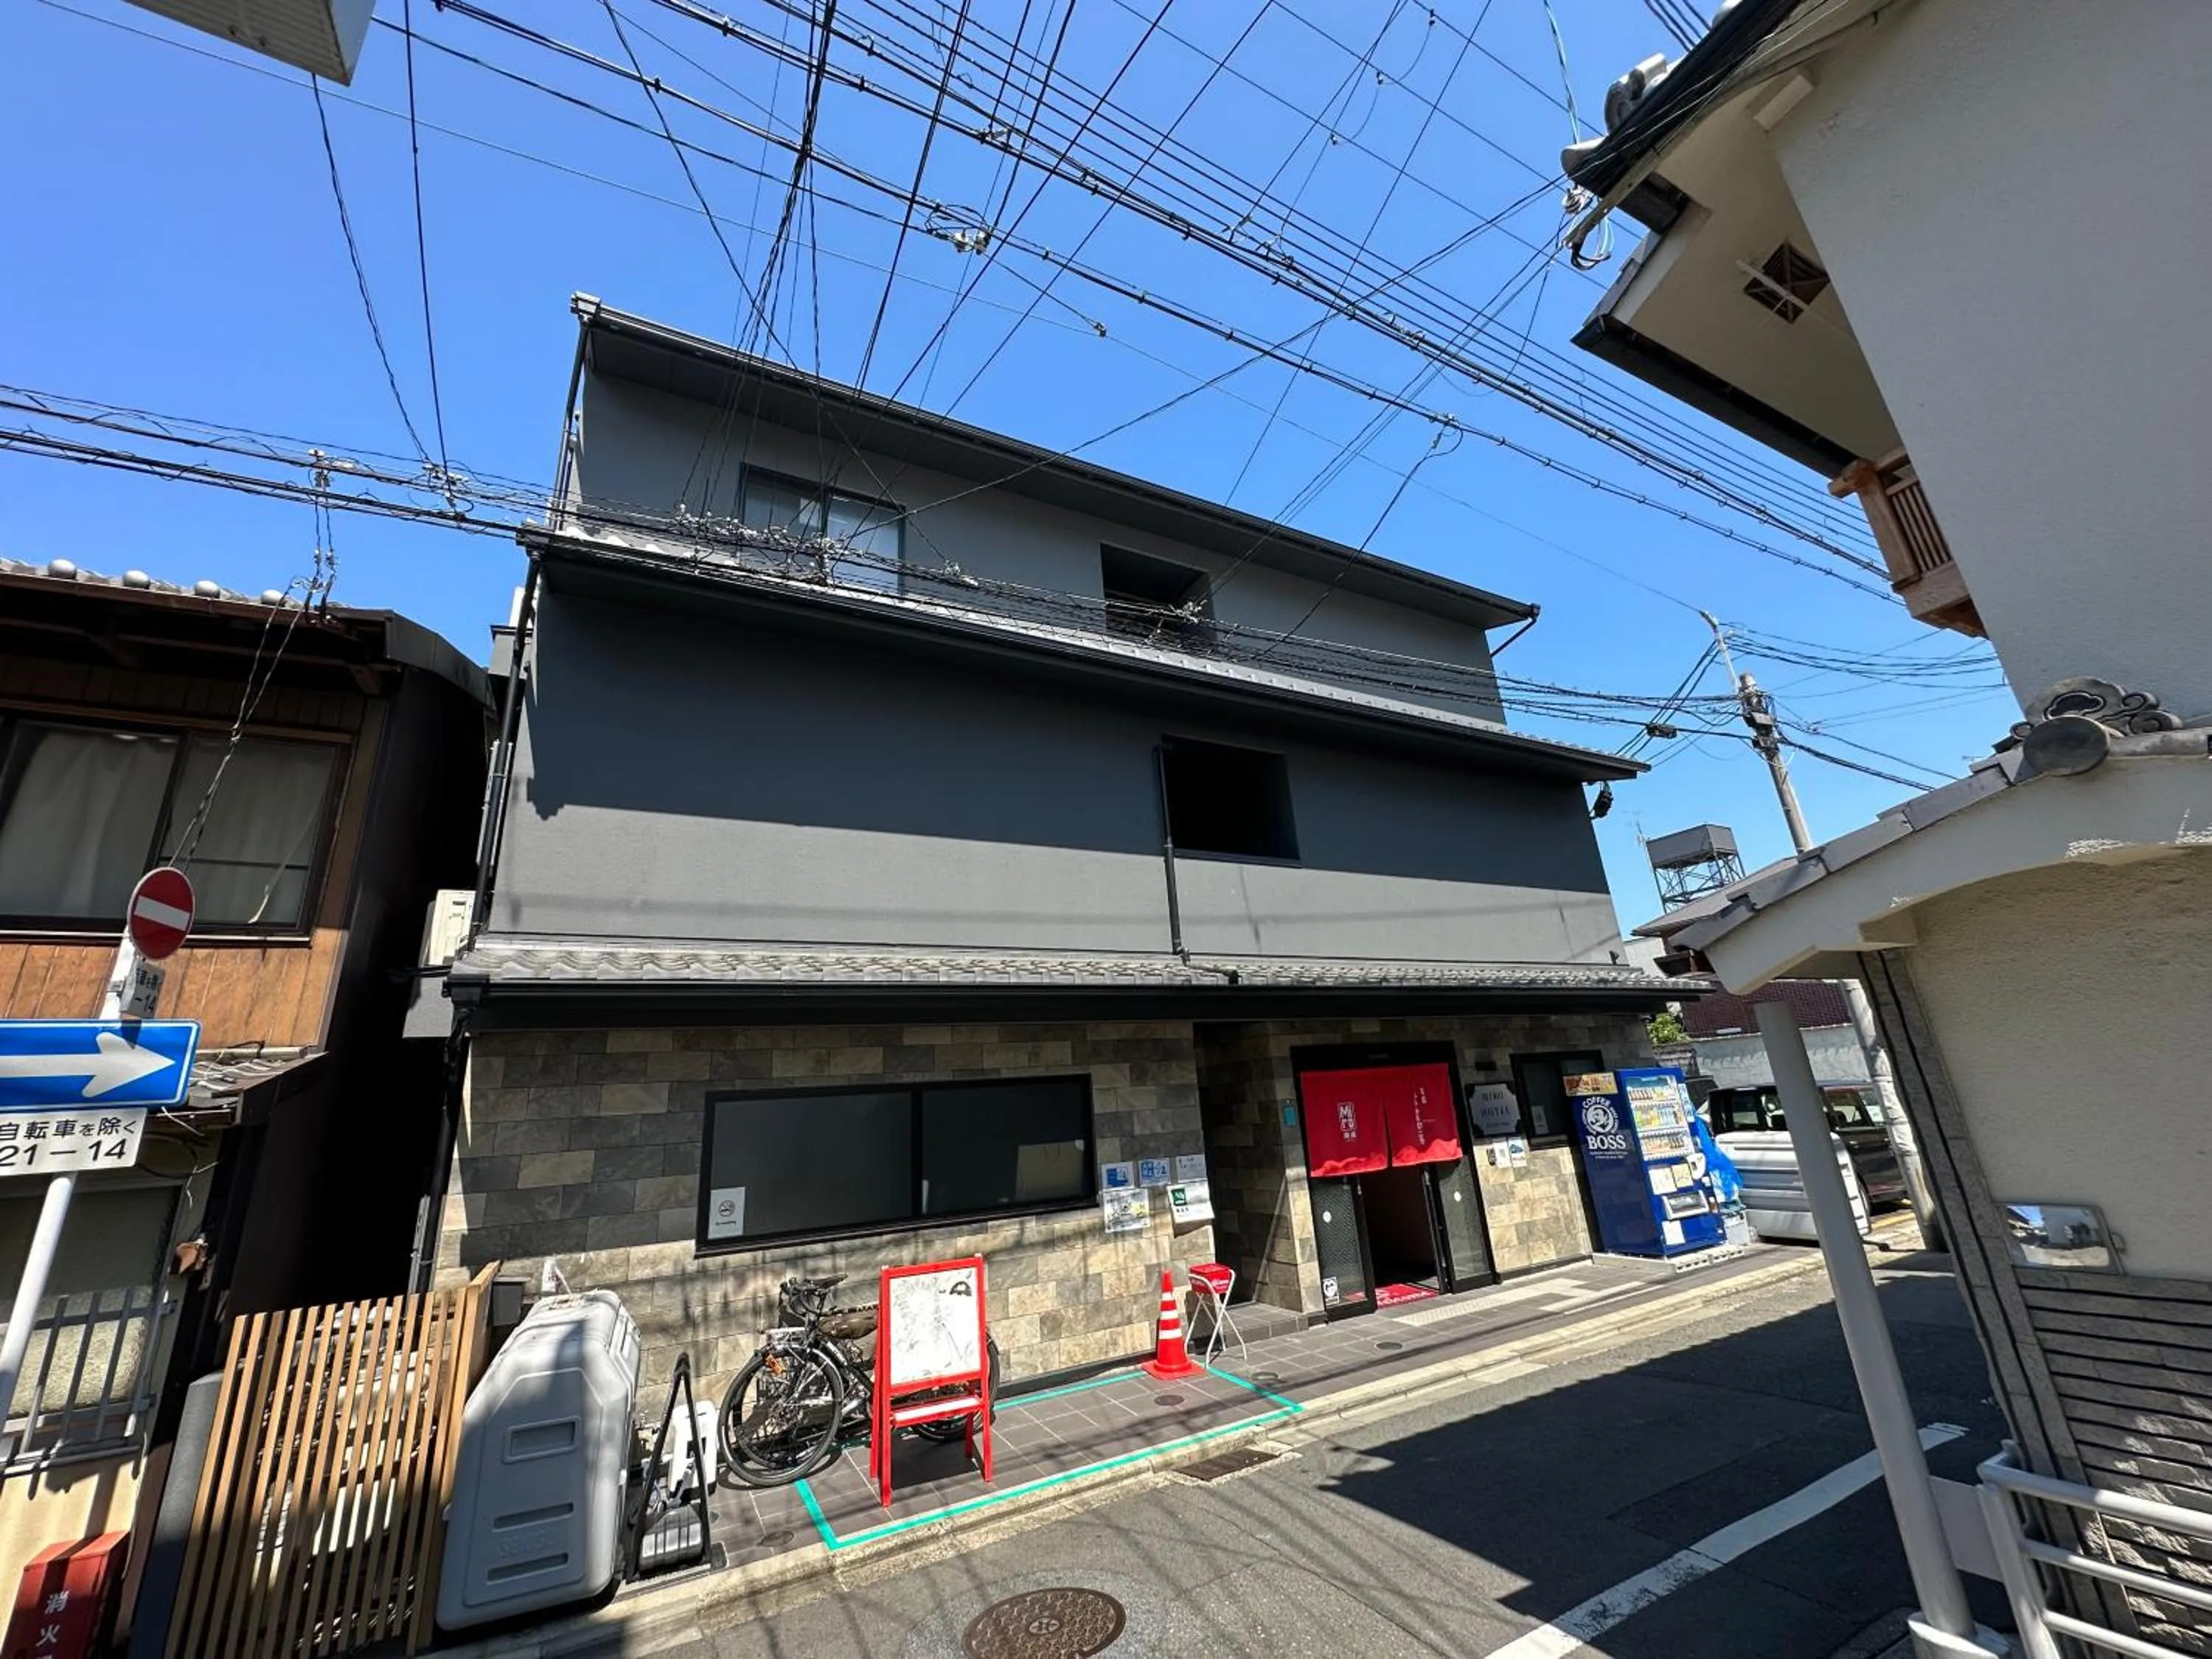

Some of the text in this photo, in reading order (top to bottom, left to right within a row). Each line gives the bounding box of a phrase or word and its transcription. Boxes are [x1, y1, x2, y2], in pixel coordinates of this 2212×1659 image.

[0, 1117, 136, 1141] 自転車を除く
[1587, 1135, 1626, 1150] BOSS
[35, 1590, 70, 1659] 消火
